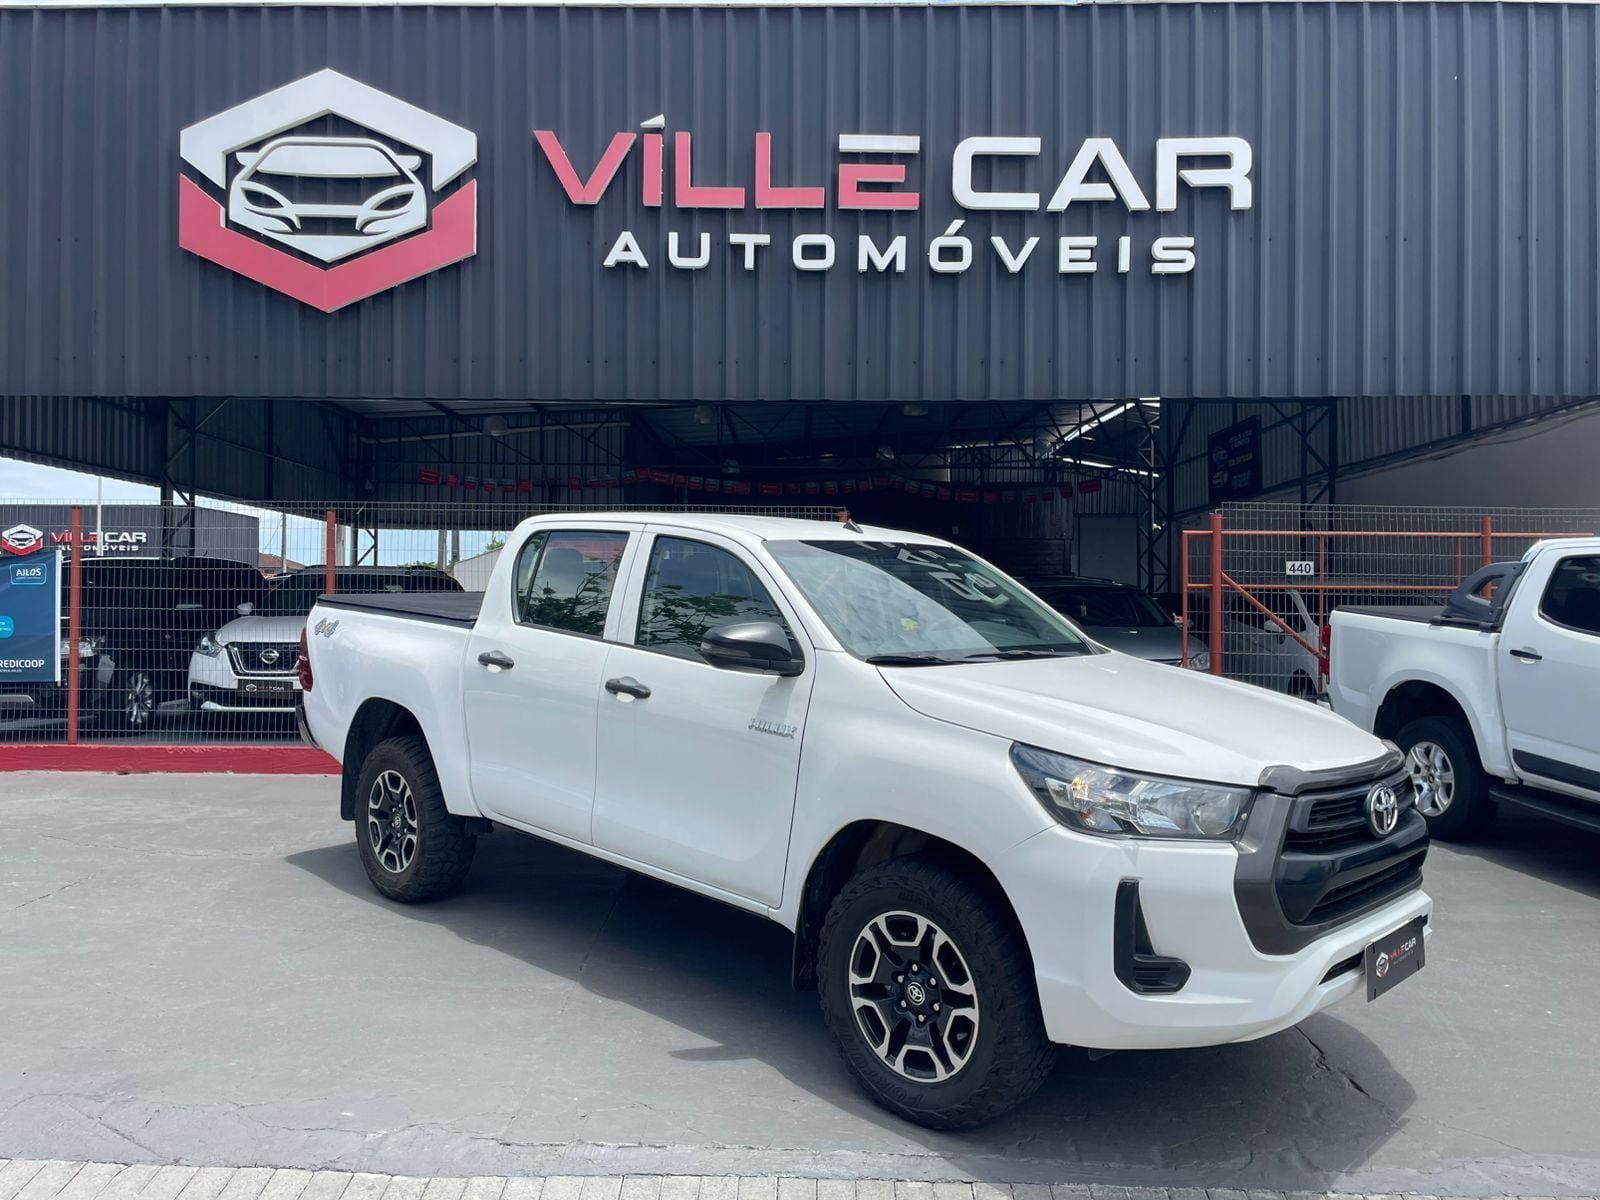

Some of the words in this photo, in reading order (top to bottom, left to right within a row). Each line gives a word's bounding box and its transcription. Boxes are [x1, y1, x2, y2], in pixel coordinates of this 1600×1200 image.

[951, 136, 1254, 212] CAR
[602, 218, 1197, 275] AUTOMÓVEIS
[49, 529, 98, 543] VÍLE
[104, 532, 147, 543] CAR
[59, 542, 139, 551] AUOMÓVEIS
[16, 567, 42, 577] AILOS
[1288, 563, 1311, 574] 440
[1404, 937, 1417, 952] CAR
